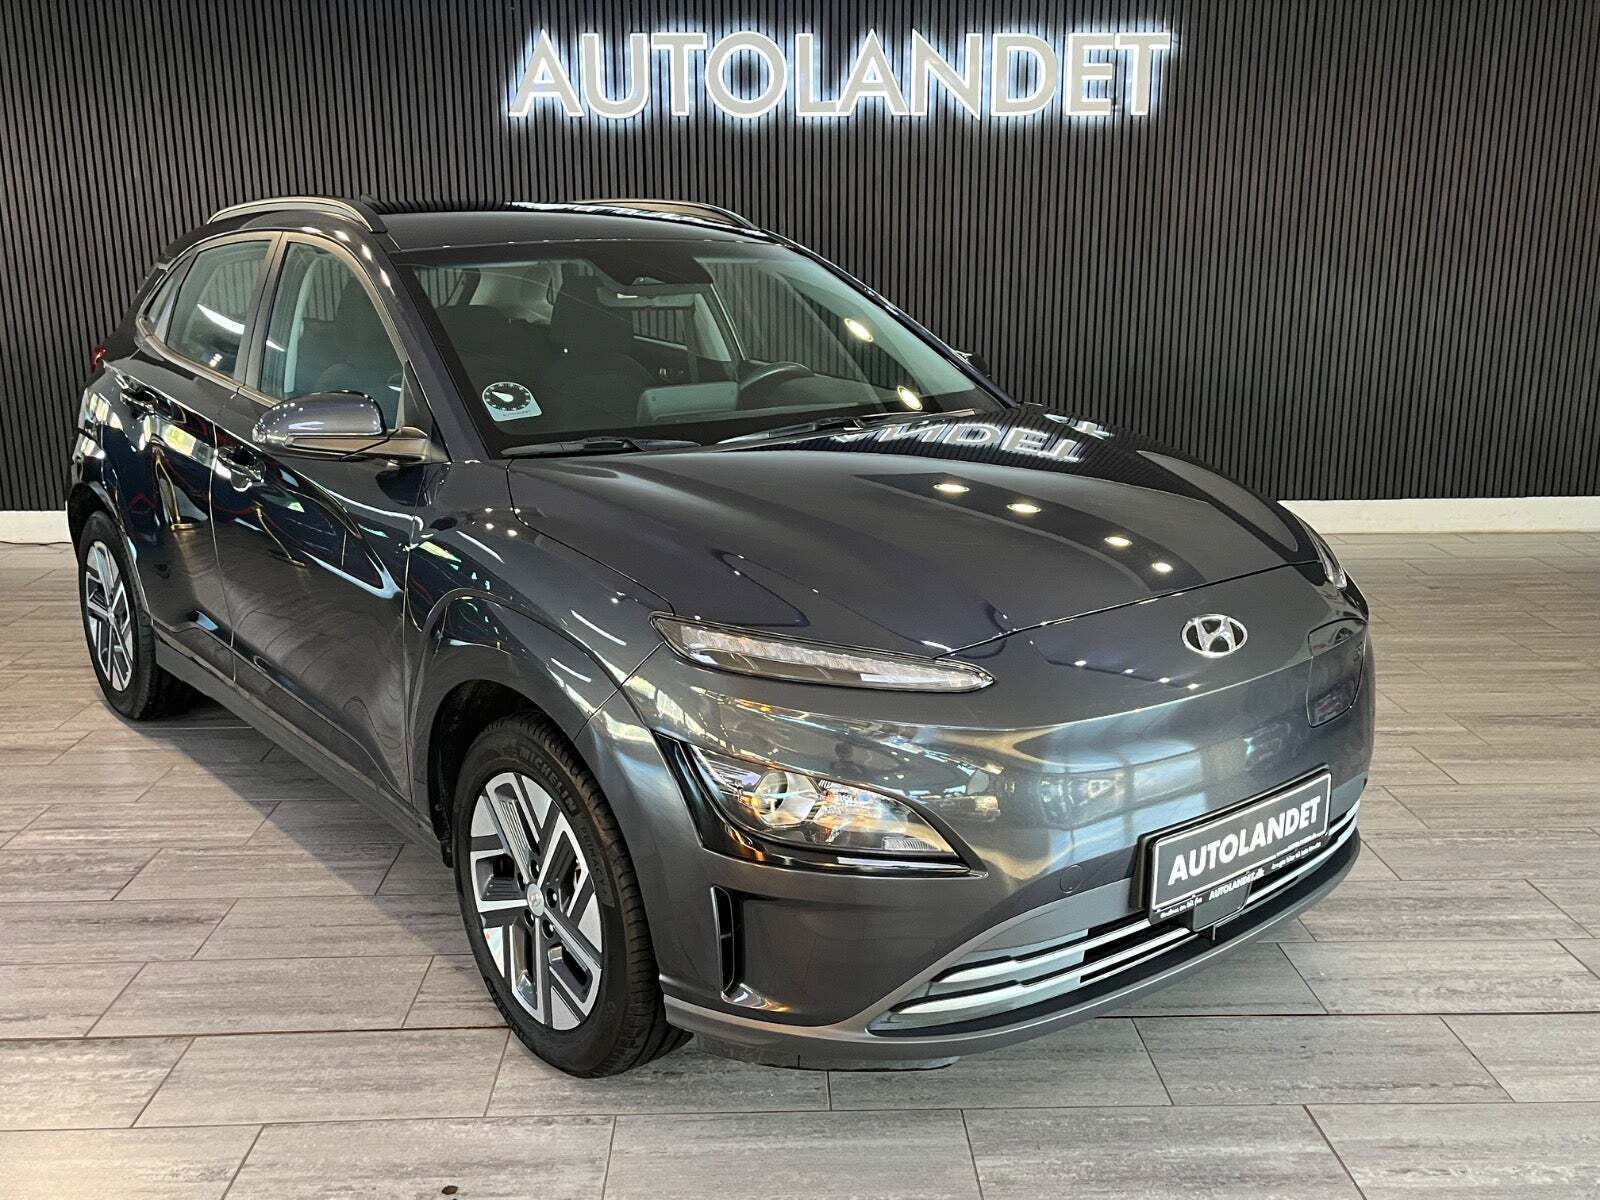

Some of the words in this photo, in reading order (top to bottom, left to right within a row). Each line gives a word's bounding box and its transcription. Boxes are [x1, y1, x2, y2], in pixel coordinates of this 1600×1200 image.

[508, 29, 1171, 120] AUTOLANDET
[518, 746, 579, 818] MICHELIN
[1167, 795, 1321, 886] AUTOLANDET
